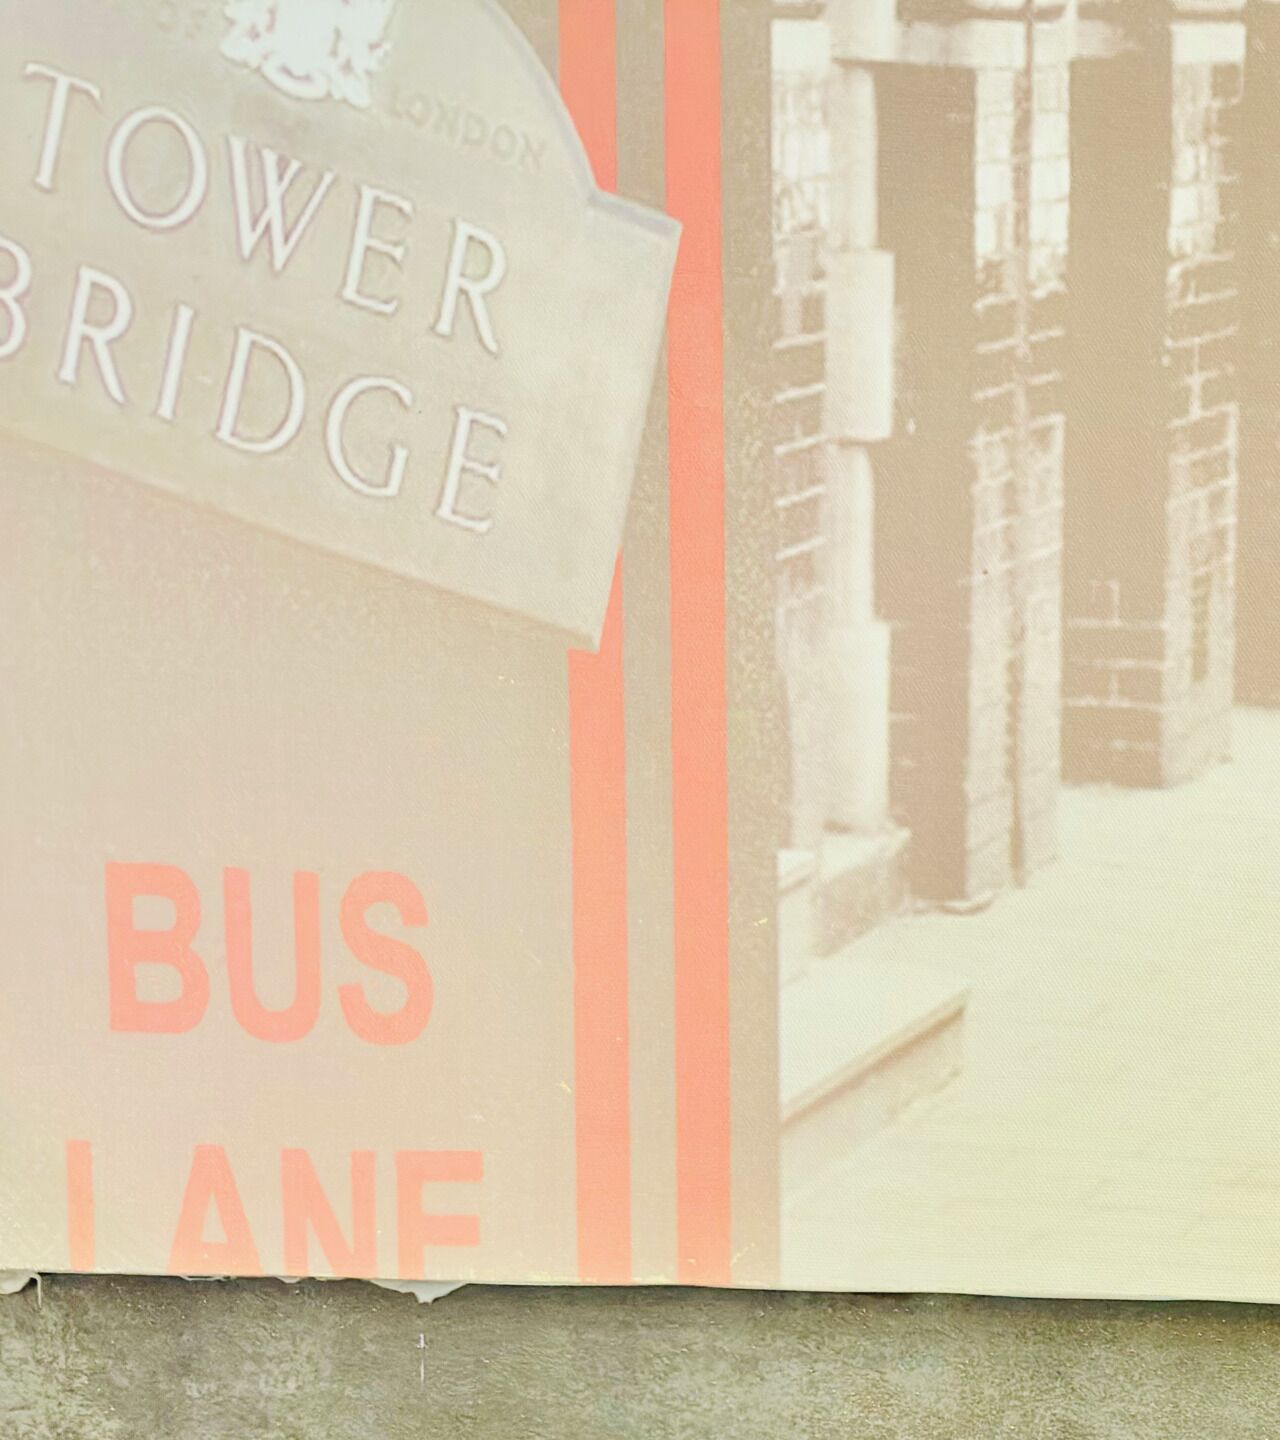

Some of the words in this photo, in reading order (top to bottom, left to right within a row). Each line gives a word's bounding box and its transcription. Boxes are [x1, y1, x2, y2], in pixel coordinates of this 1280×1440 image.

[25, 62, 507, 354] TOWER
[391, 86, 547, 172] LONDON
[105, 861, 433, 1046] BUS
